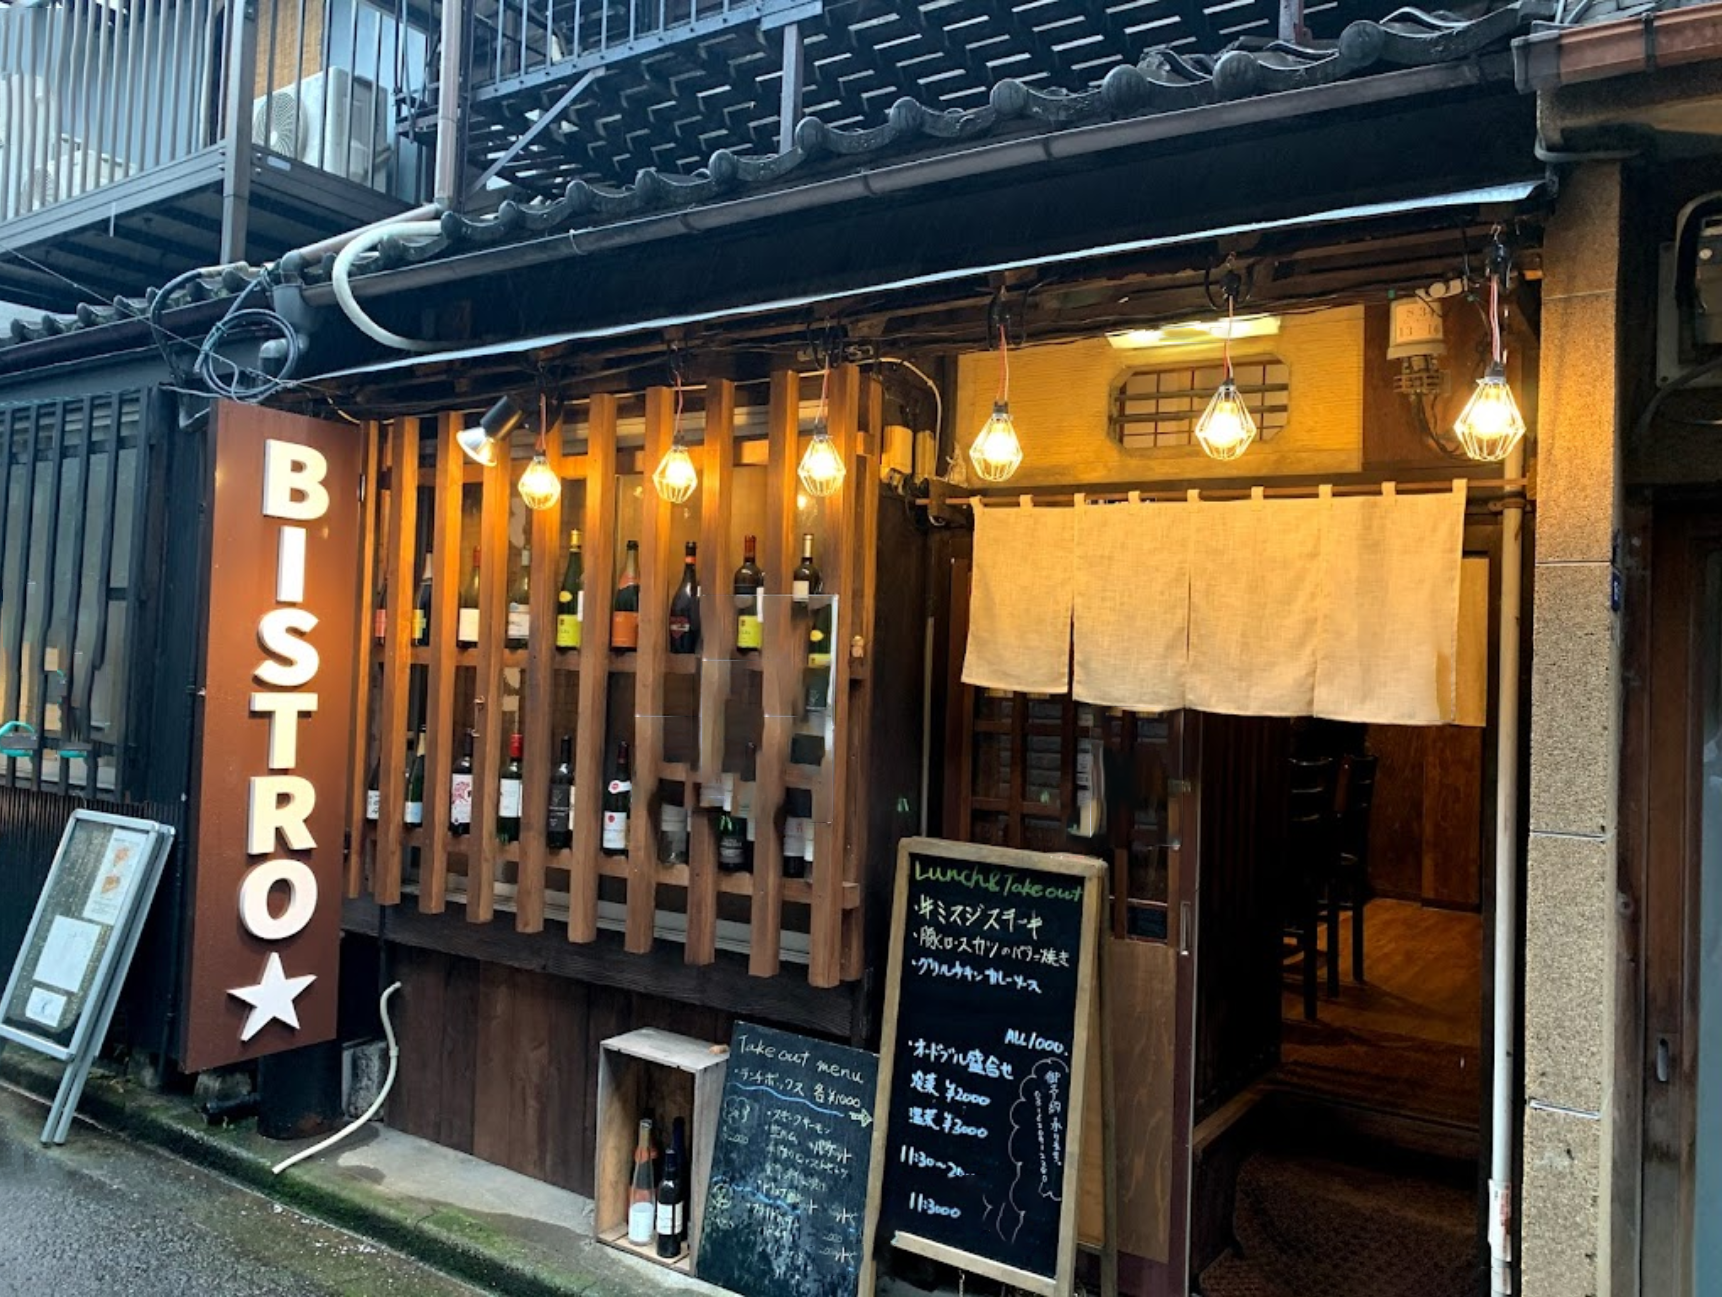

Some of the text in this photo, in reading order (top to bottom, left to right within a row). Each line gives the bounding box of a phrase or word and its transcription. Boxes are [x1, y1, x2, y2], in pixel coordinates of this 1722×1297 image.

[239, 439, 331, 941] BISTRO
[738, 1034, 865, 1085] Take out menu
